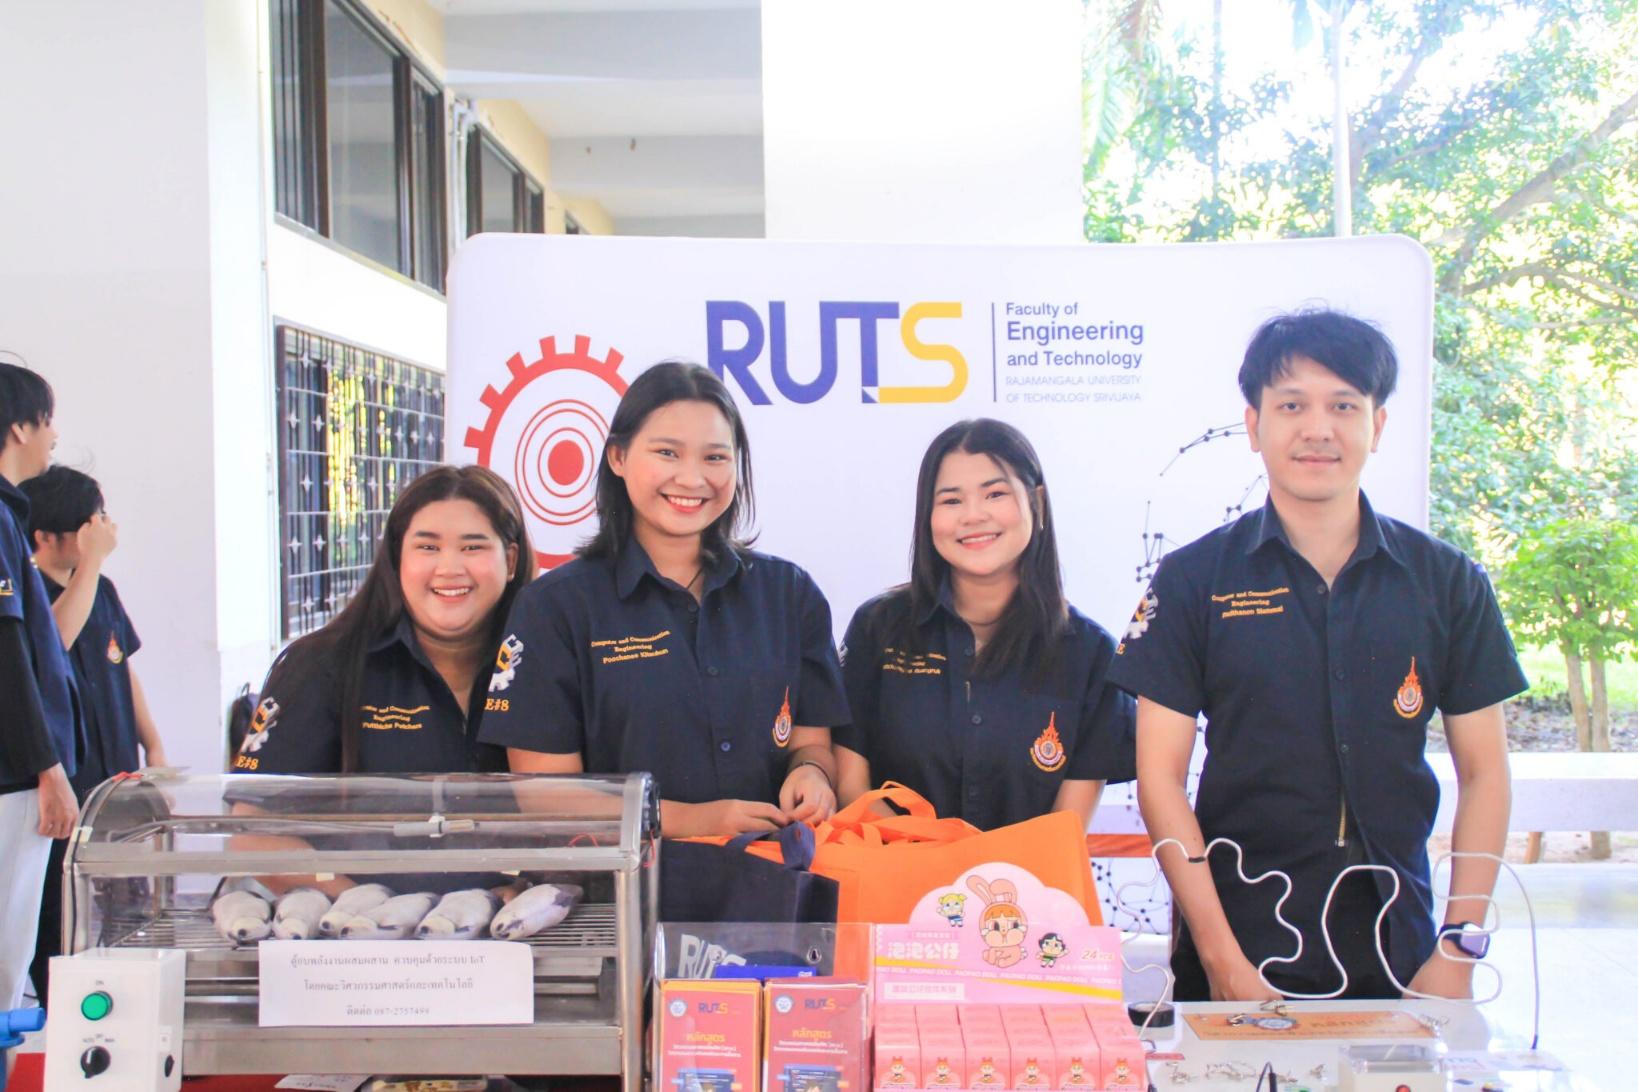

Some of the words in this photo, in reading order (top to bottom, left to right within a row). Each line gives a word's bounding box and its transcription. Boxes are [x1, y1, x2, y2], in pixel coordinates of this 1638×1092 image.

[1006, 302, 1060, 318] Faculty
[1064, 302, 1078, 315] of
[1007, 320, 1144, 346] Engineering
[706, 301, 969, 406] RUTS
[1007, 351, 1038, 366] and
[1043, 350, 1143, 369] Technology
[1006, 376, 1084, 386] RAJAMANGALA
[1088, 375, 1142, 385] UNIVERSITY
[1023, 393, 1090, 403] TECHNOLOGY
[678, 934, 747, 979] RUT
